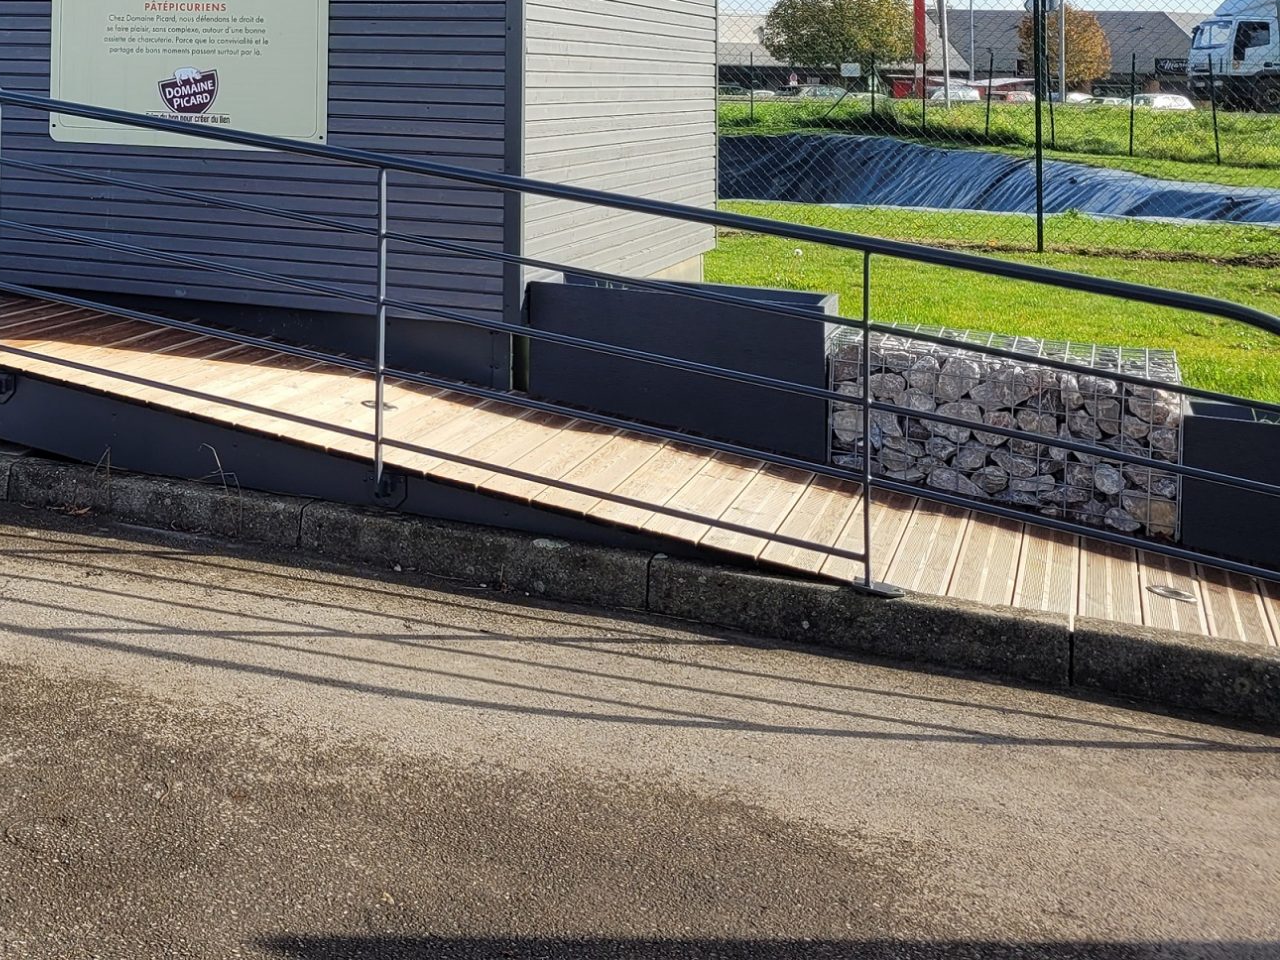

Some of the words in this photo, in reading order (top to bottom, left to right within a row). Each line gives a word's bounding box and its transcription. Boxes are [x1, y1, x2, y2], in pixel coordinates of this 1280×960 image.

[144, 1, 227, 12] PÂTÉPICURIENS
[156, 15, 177, 24] Picard,
[130, 26, 151, 35] plaisir,
[168, 26, 201, 36] complexe,
[128, 36, 136, 44] de
[217, 37, 253, 45] convivialité
[145, 47, 160, 55] bons
[192, 48, 216, 57] passent
[241, 50, 253, 58] par
[165, 80, 215, 99] DOMAINE
[173, 93, 210, 109] PICARD
[194, 115, 210, 123] créer
[220, 116, 231, 124] lien
